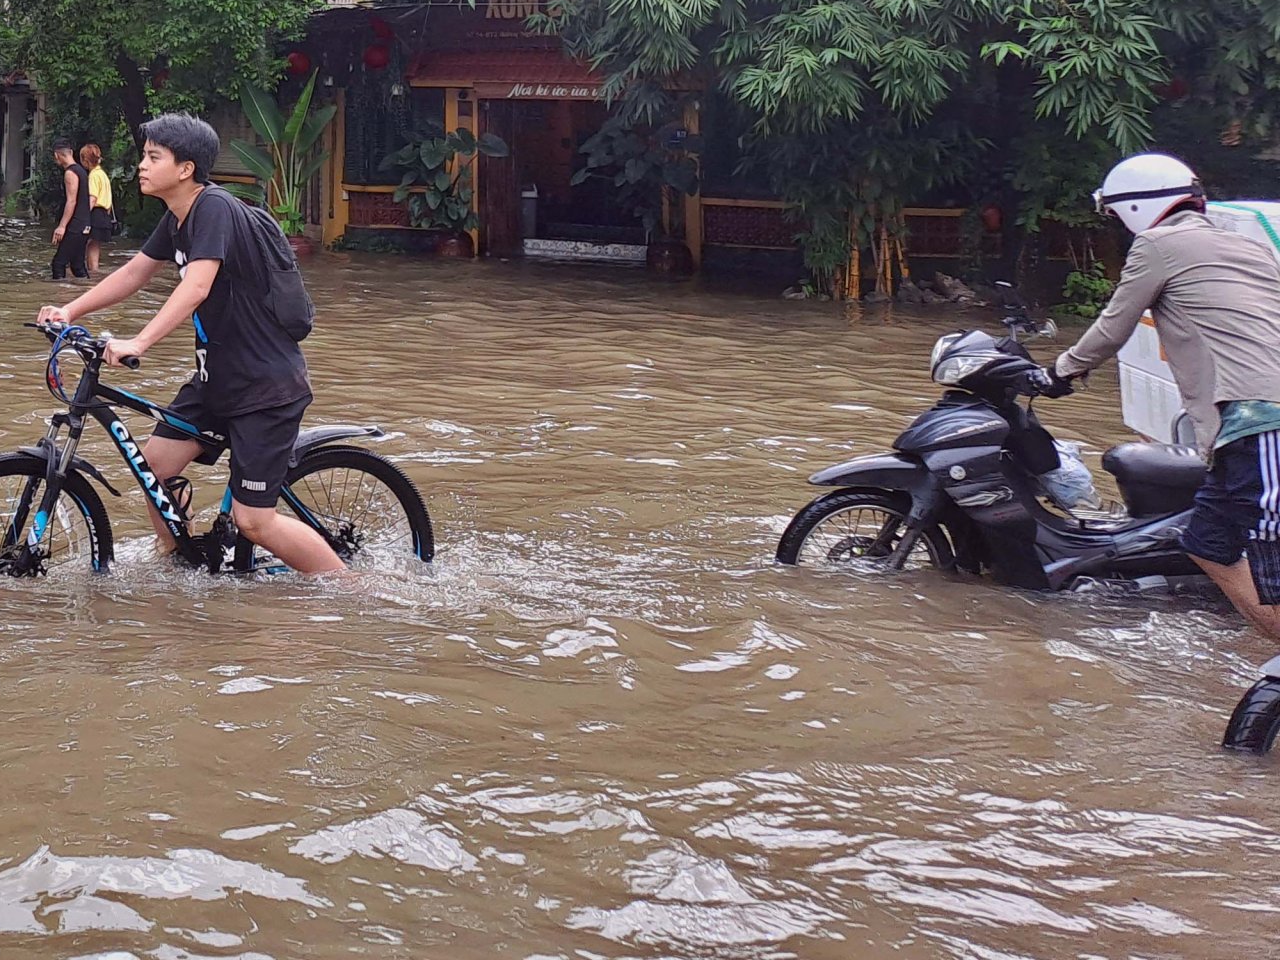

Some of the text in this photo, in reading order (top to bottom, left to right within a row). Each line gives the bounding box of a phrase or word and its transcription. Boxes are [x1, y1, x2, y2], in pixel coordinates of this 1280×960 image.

[110, 420, 181, 522] GALAXY
[241, 479, 267, 491] PUMA
[168, 521, 181, 536] CYCLE
